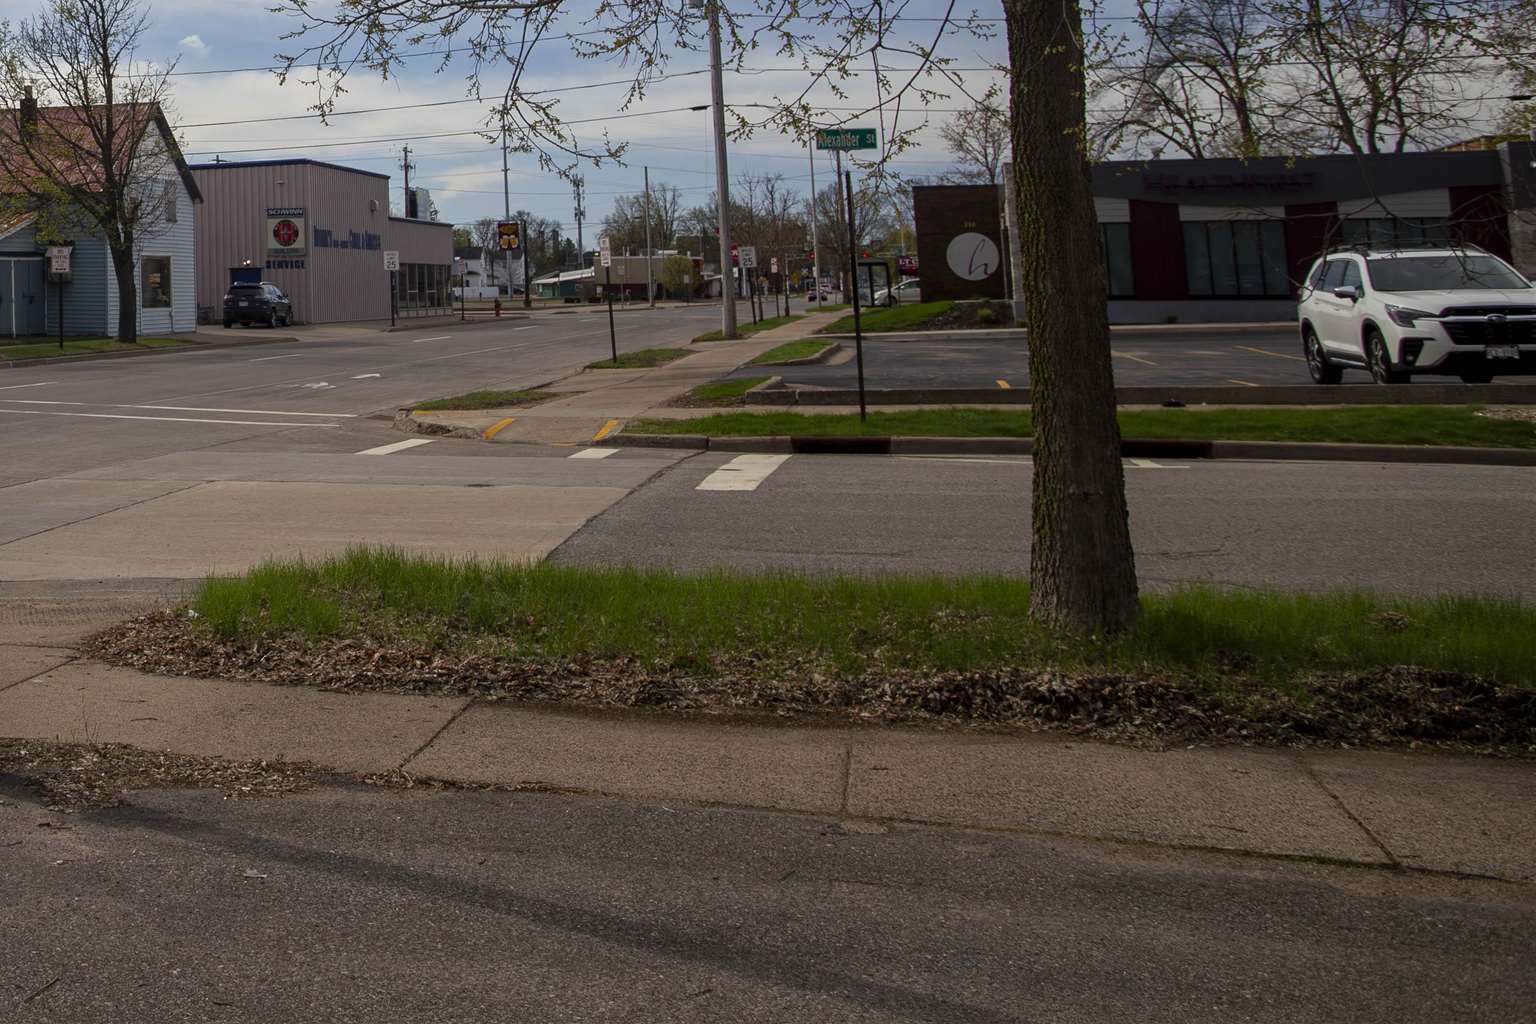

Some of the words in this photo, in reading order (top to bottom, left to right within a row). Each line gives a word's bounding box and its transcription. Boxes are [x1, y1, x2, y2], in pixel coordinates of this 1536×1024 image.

[265, 259, 305, 270] SERVICE
[386, 260, 396, 269] 25
[743, 256, 753, 266] 25
